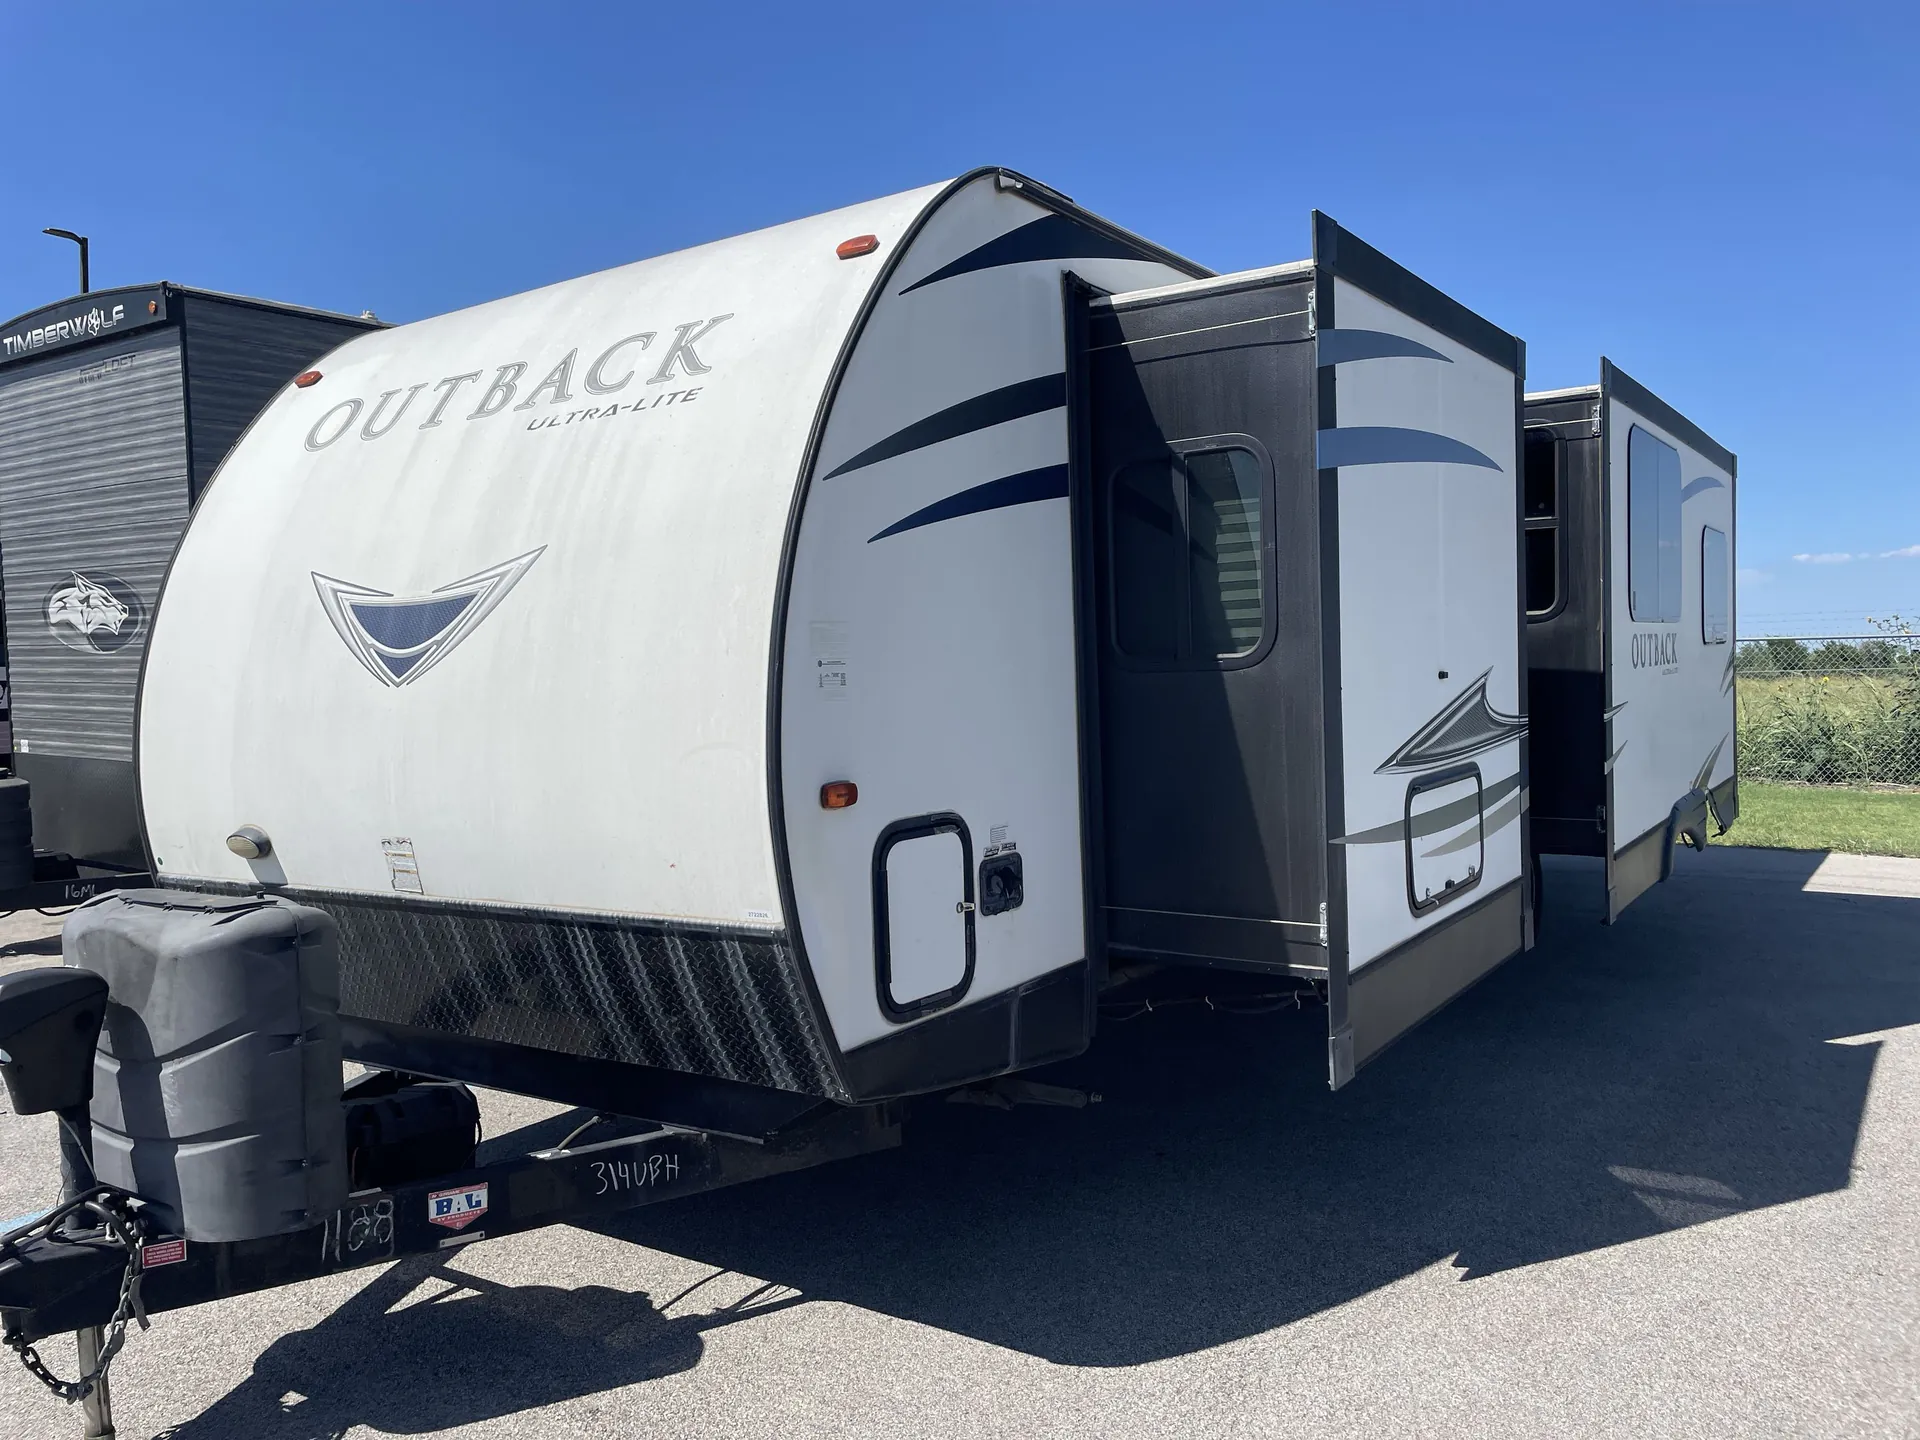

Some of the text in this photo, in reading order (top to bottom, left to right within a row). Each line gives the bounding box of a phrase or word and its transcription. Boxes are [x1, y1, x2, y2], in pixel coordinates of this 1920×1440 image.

[304, 313, 734, 452] OUTBACK
[526, 387, 704, 431] ULTRA-LITE
[1631, 633, 1677, 669] OUTBACK
[590, 1154, 680, 1195] 314UBH
[435, 1193, 482, 1216] BAL
